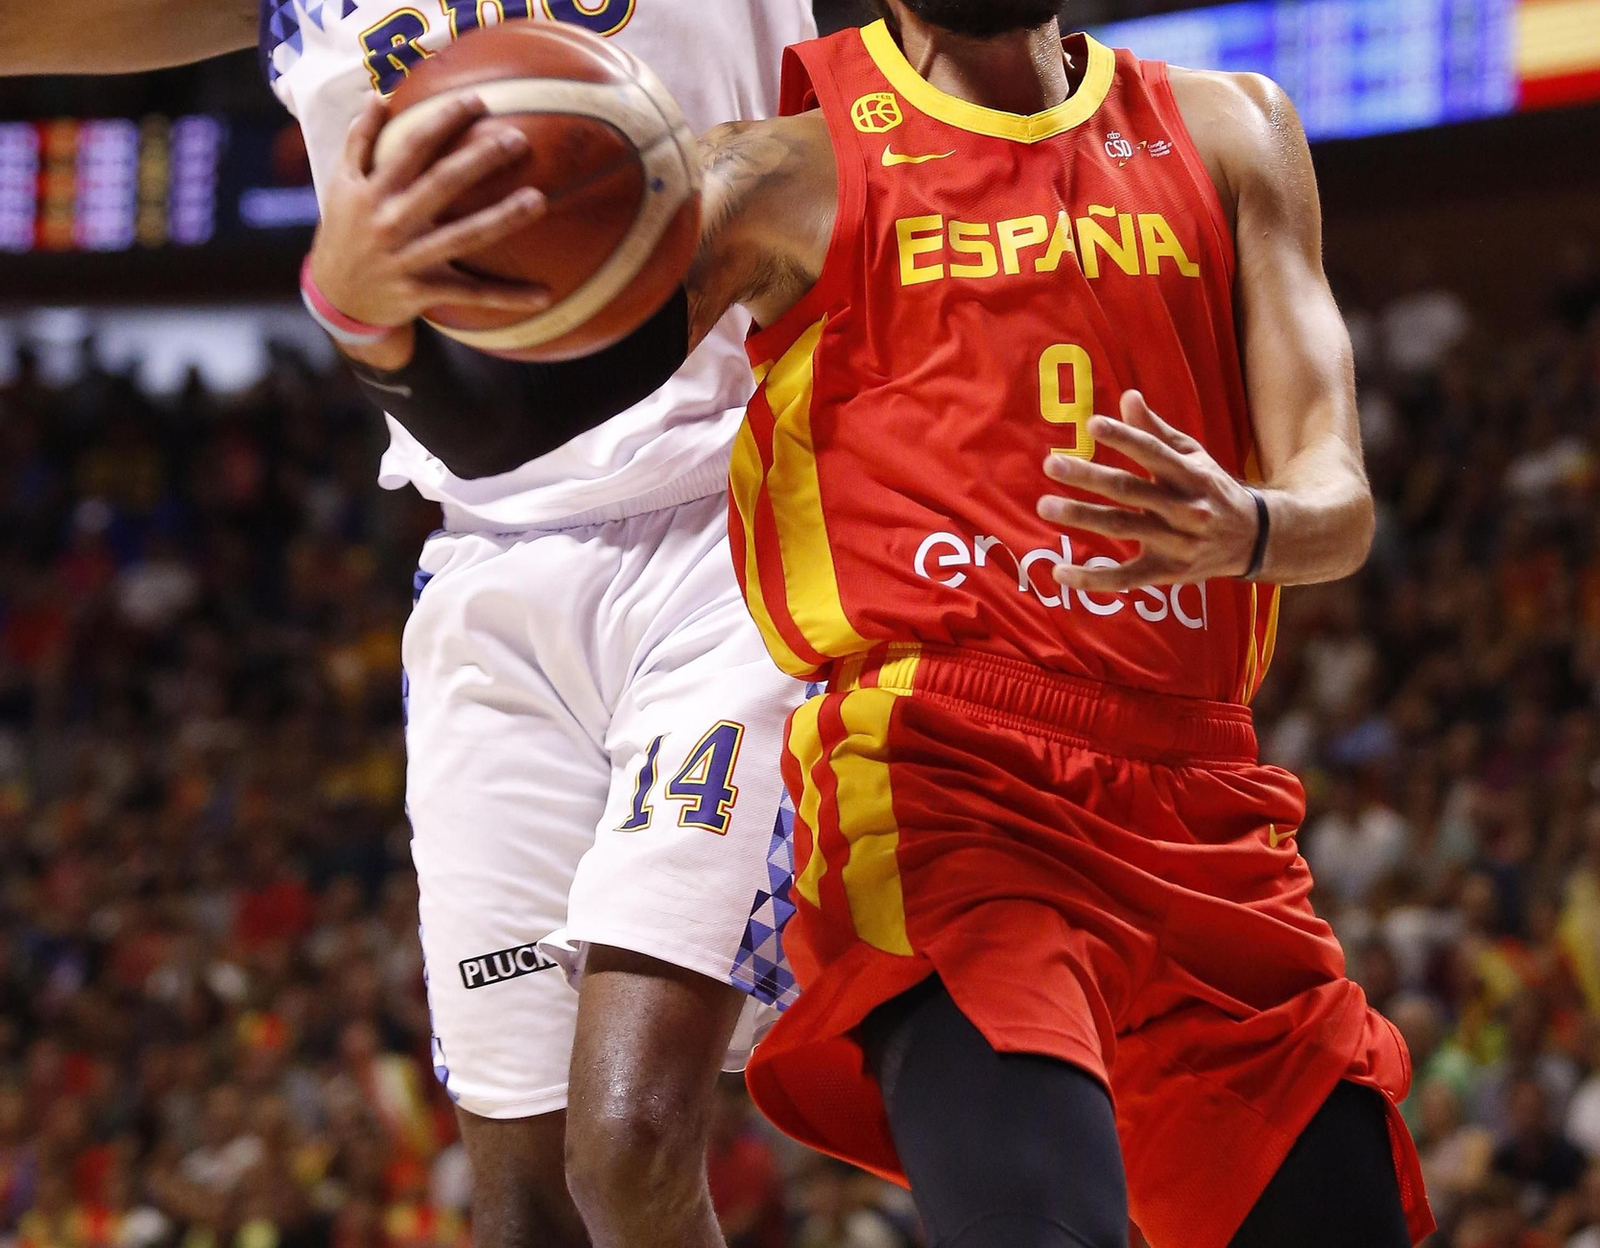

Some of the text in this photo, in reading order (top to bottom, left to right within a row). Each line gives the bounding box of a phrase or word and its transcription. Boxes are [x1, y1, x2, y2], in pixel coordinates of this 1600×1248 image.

[1105, 140, 1132, 158] CSD
[896, 204, 1201, 286] ESPAÑA
[1038, 343, 1096, 462] 9
[612, 719, 745, 836] 14
